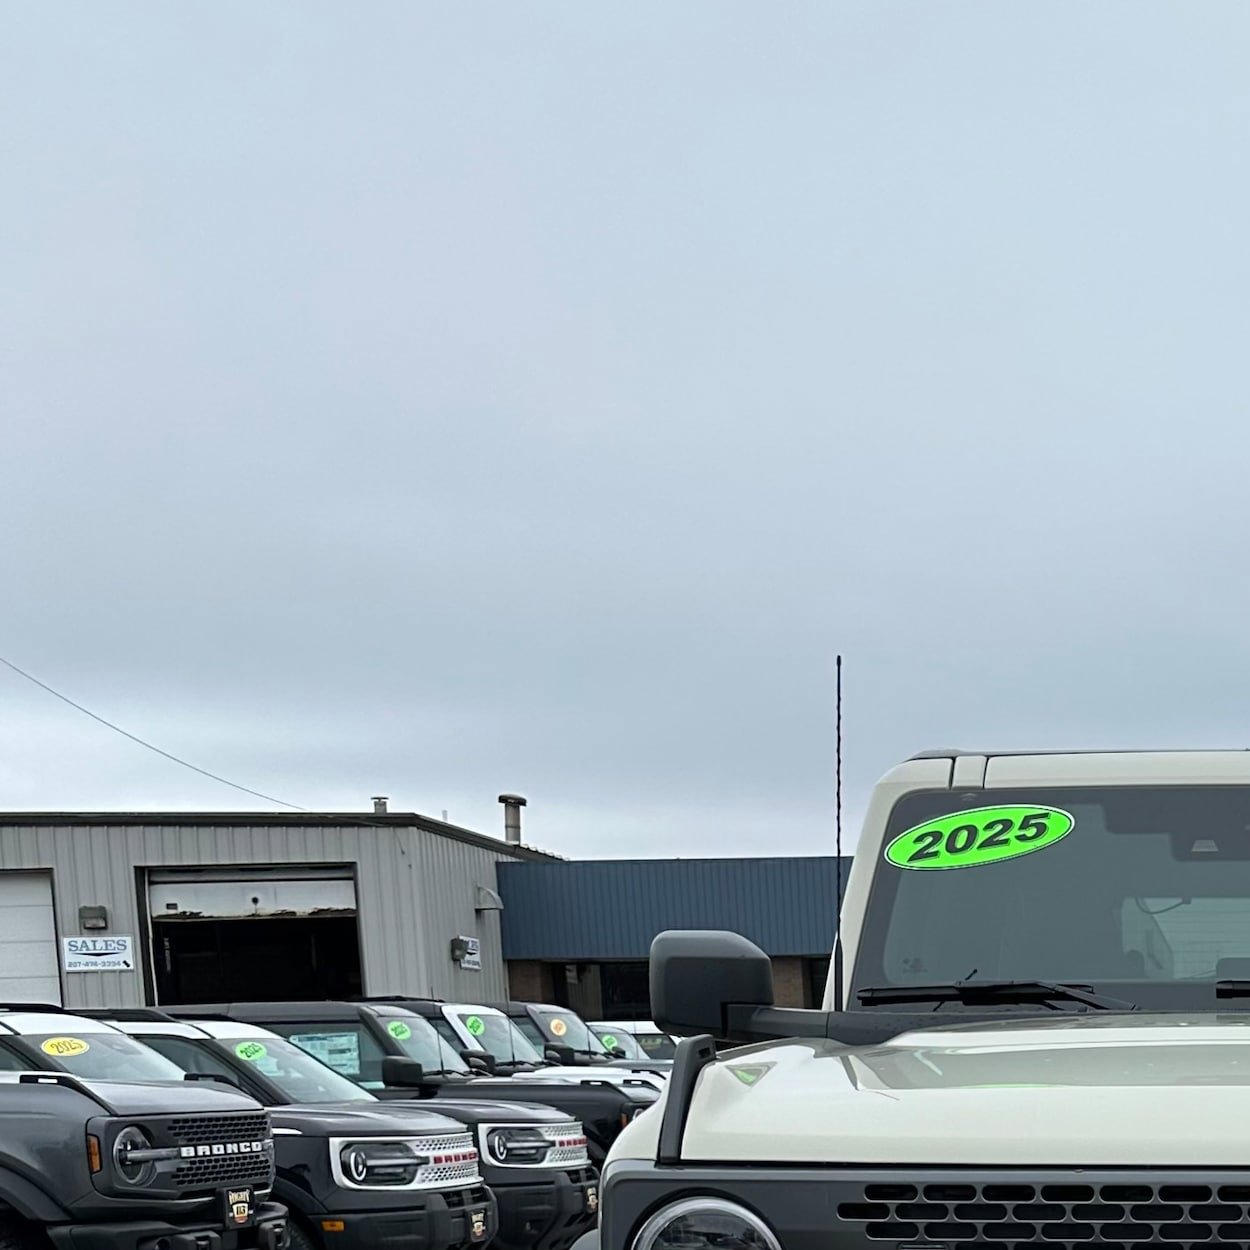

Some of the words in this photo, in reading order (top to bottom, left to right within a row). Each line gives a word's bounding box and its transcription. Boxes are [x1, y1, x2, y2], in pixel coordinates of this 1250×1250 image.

[907, 812, 1052, 863] 2025
[68, 939, 127, 952] SALES
[181, 1141, 262, 1157] BRONCO
